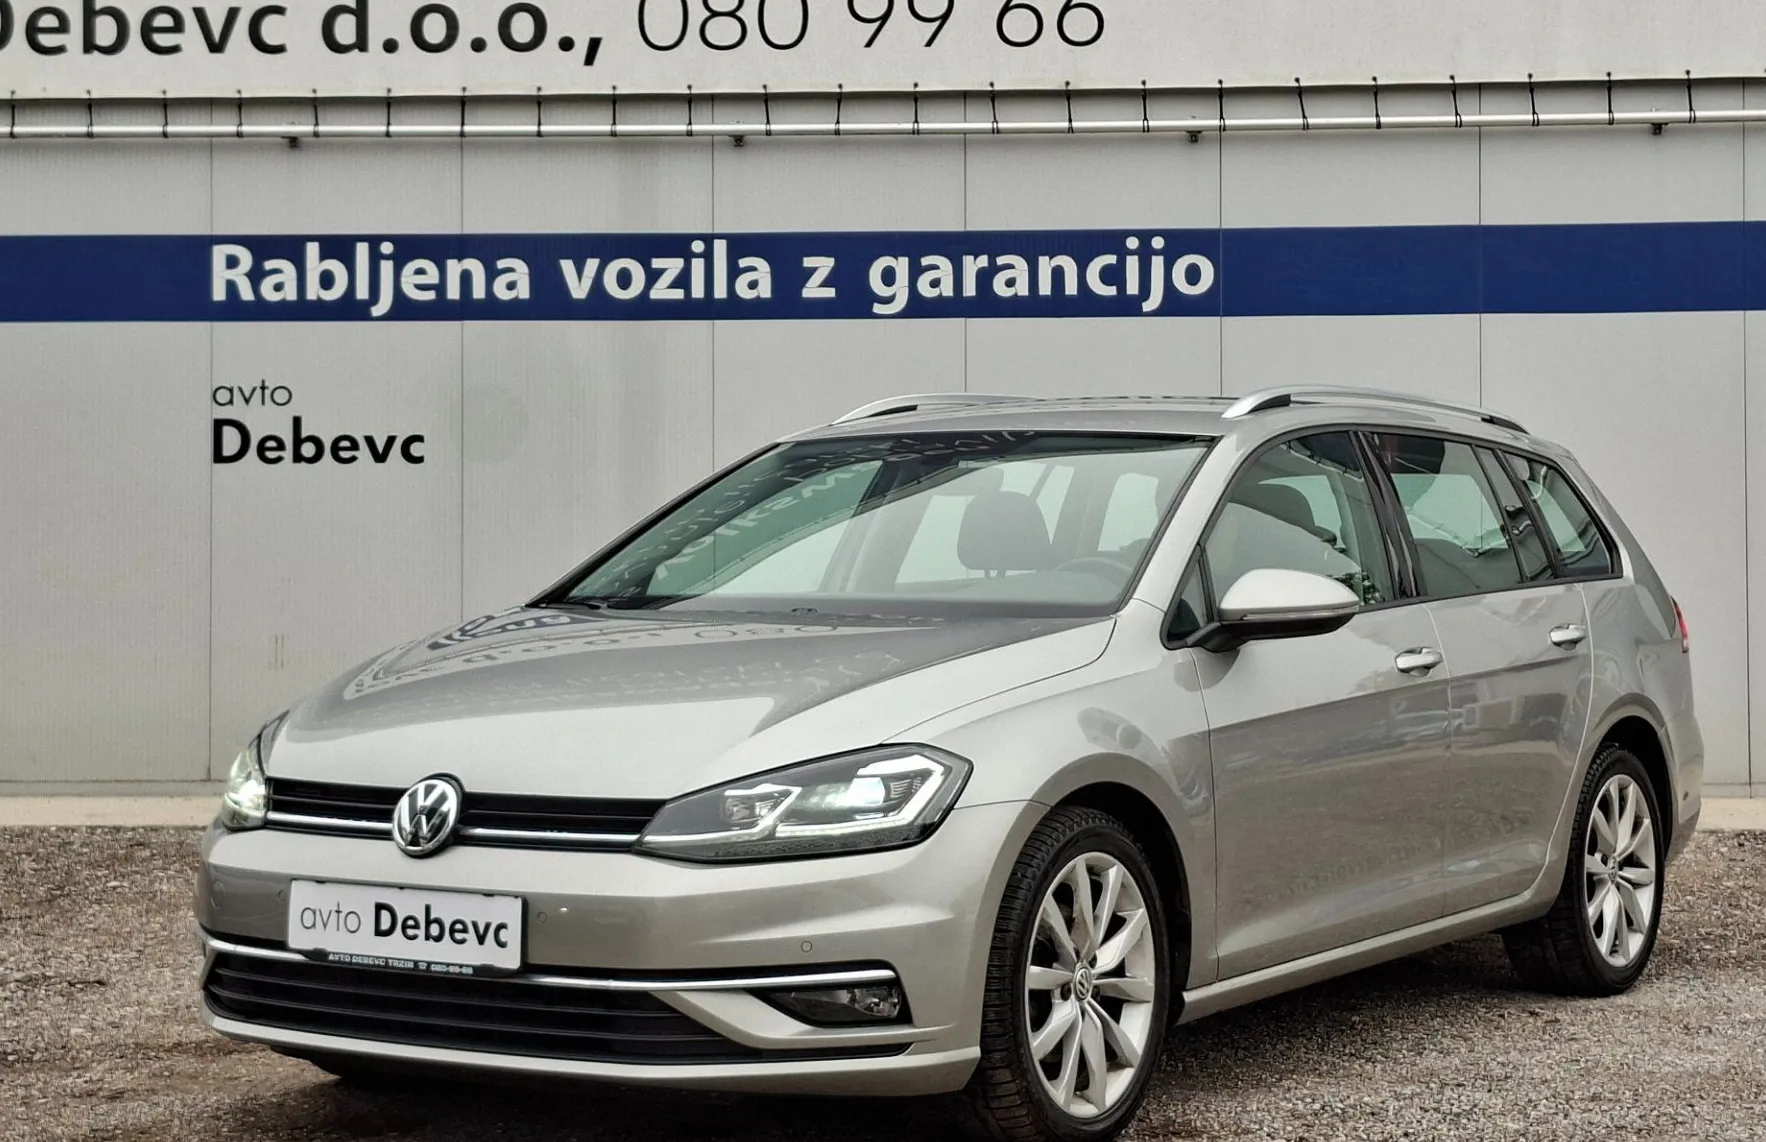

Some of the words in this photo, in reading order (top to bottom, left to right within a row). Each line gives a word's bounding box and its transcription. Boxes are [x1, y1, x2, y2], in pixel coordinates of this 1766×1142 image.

[0, 0, 288, 56] ebevc
[322, 0, 603, 67] d.o.o.,
[638, 0, 809, 52] 080
[847, 0, 955, 49] 99
[995, 0, 1105, 48] 66
[212, 242, 530, 317] Rabljena
[560, 239, 772, 300] vozila
[802, 257, 836, 298] z
[869, 236, 1215, 315] garancijo
[212, 379, 293, 407] avto
[213, 416, 425, 465] Debevc
[300, 902, 361, 934] avto
[373, 901, 509, 949] Debevc
[328, 953, 351, 964] AVTO
[352, 956, 386, 967] DEBEVC
